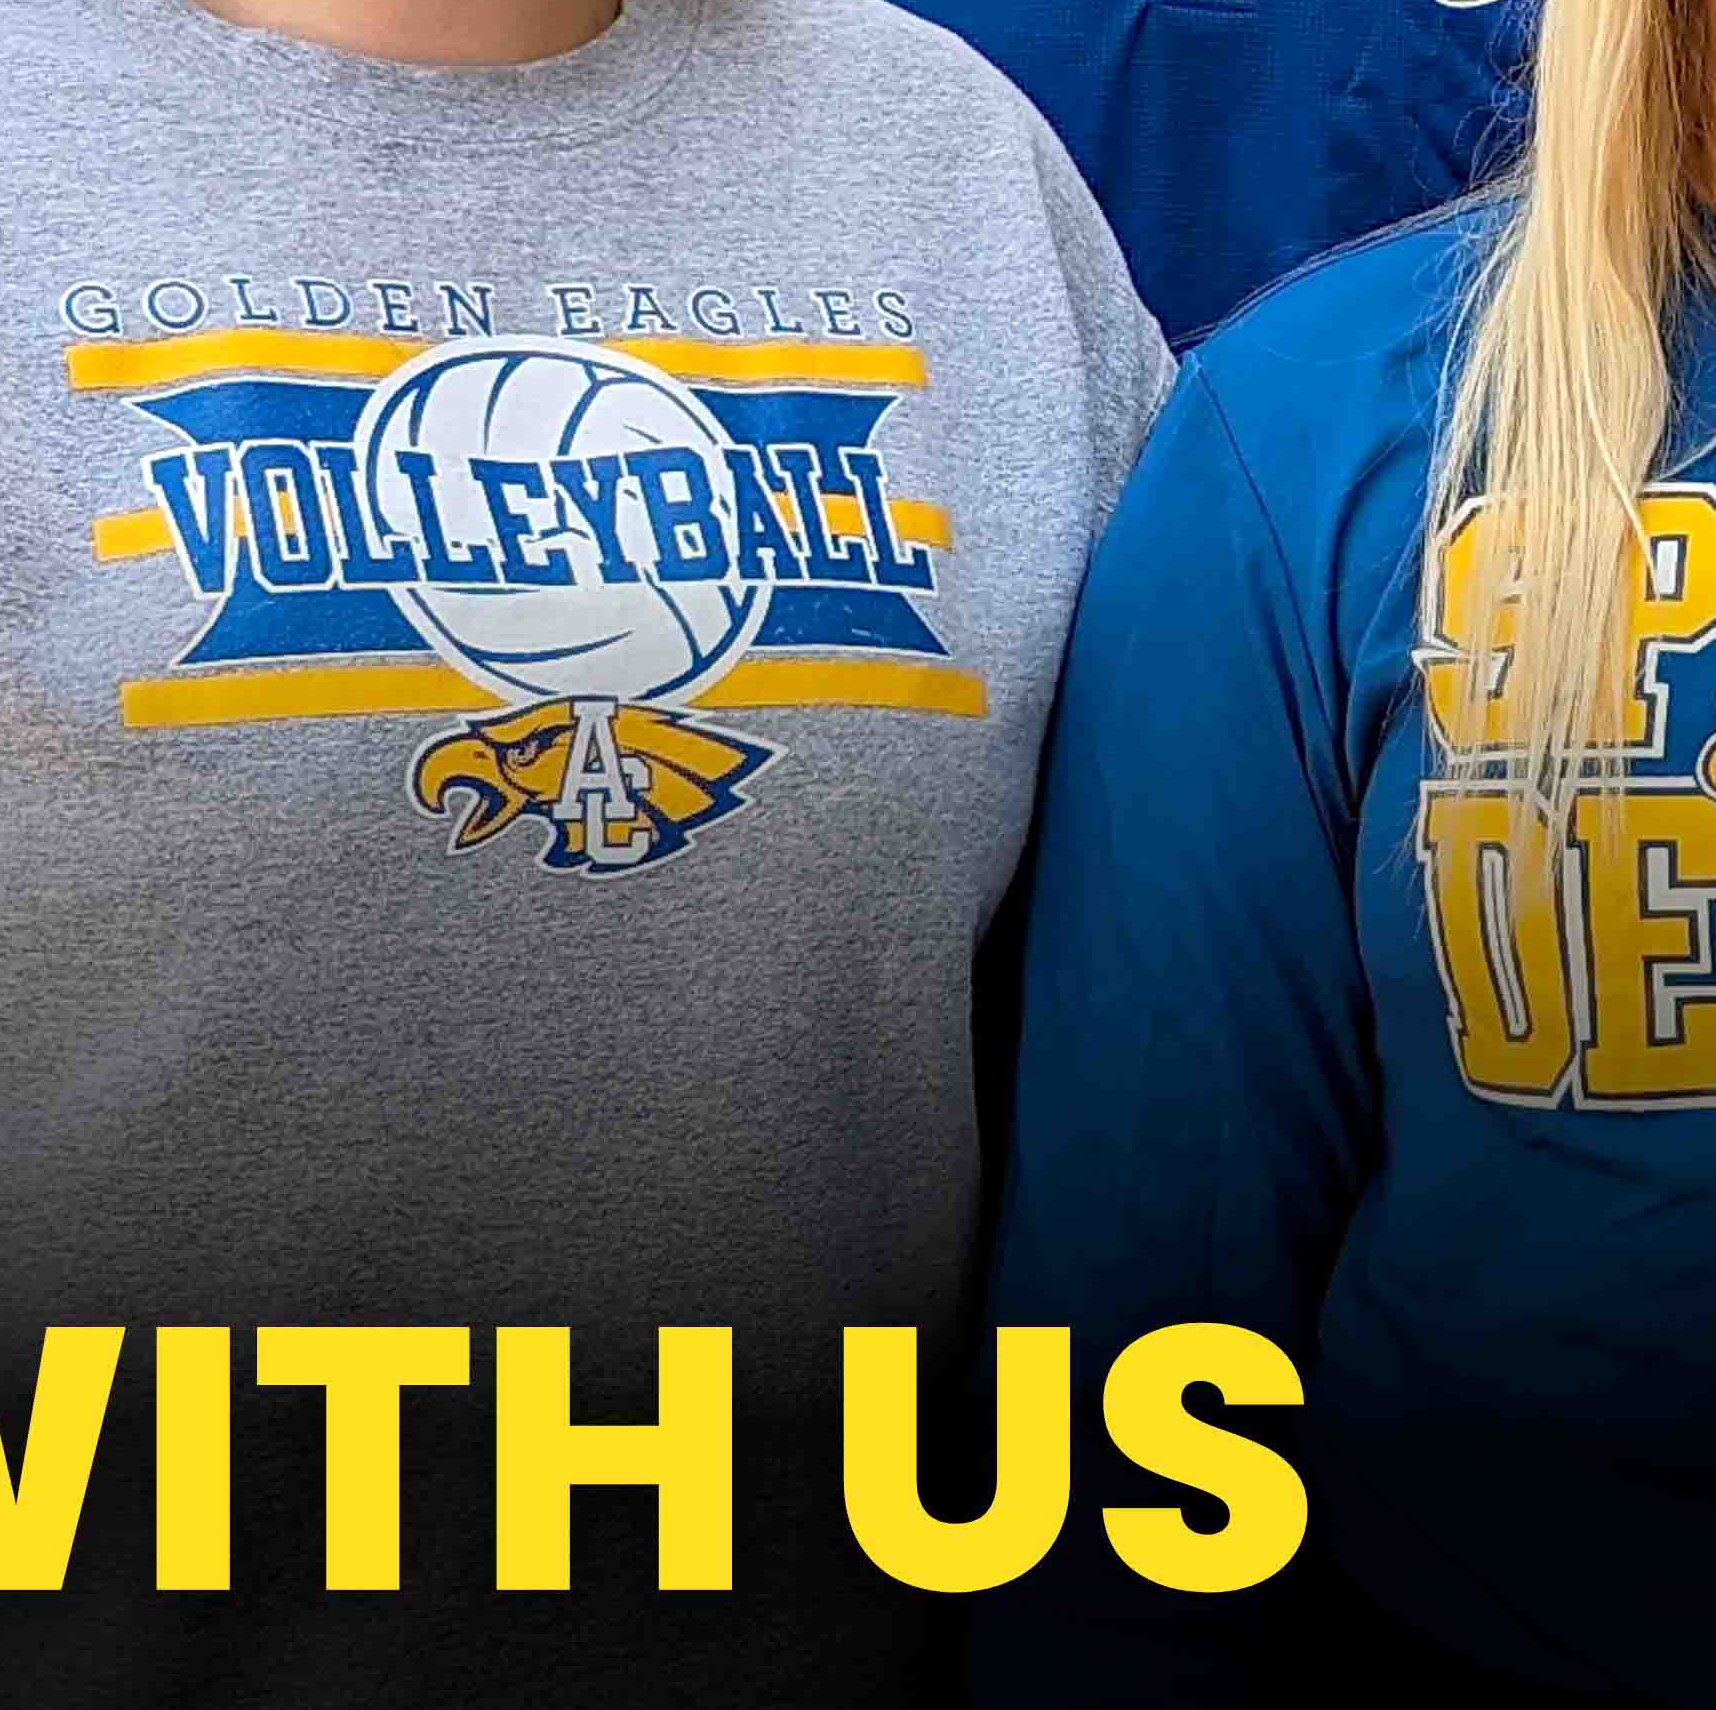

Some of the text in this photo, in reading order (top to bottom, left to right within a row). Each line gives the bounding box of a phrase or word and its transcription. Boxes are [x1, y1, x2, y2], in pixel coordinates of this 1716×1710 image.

[60, 277, 918, 342] GOLDEN EAGLES
[145, 440, 937, 596] VOLLEYBALL
